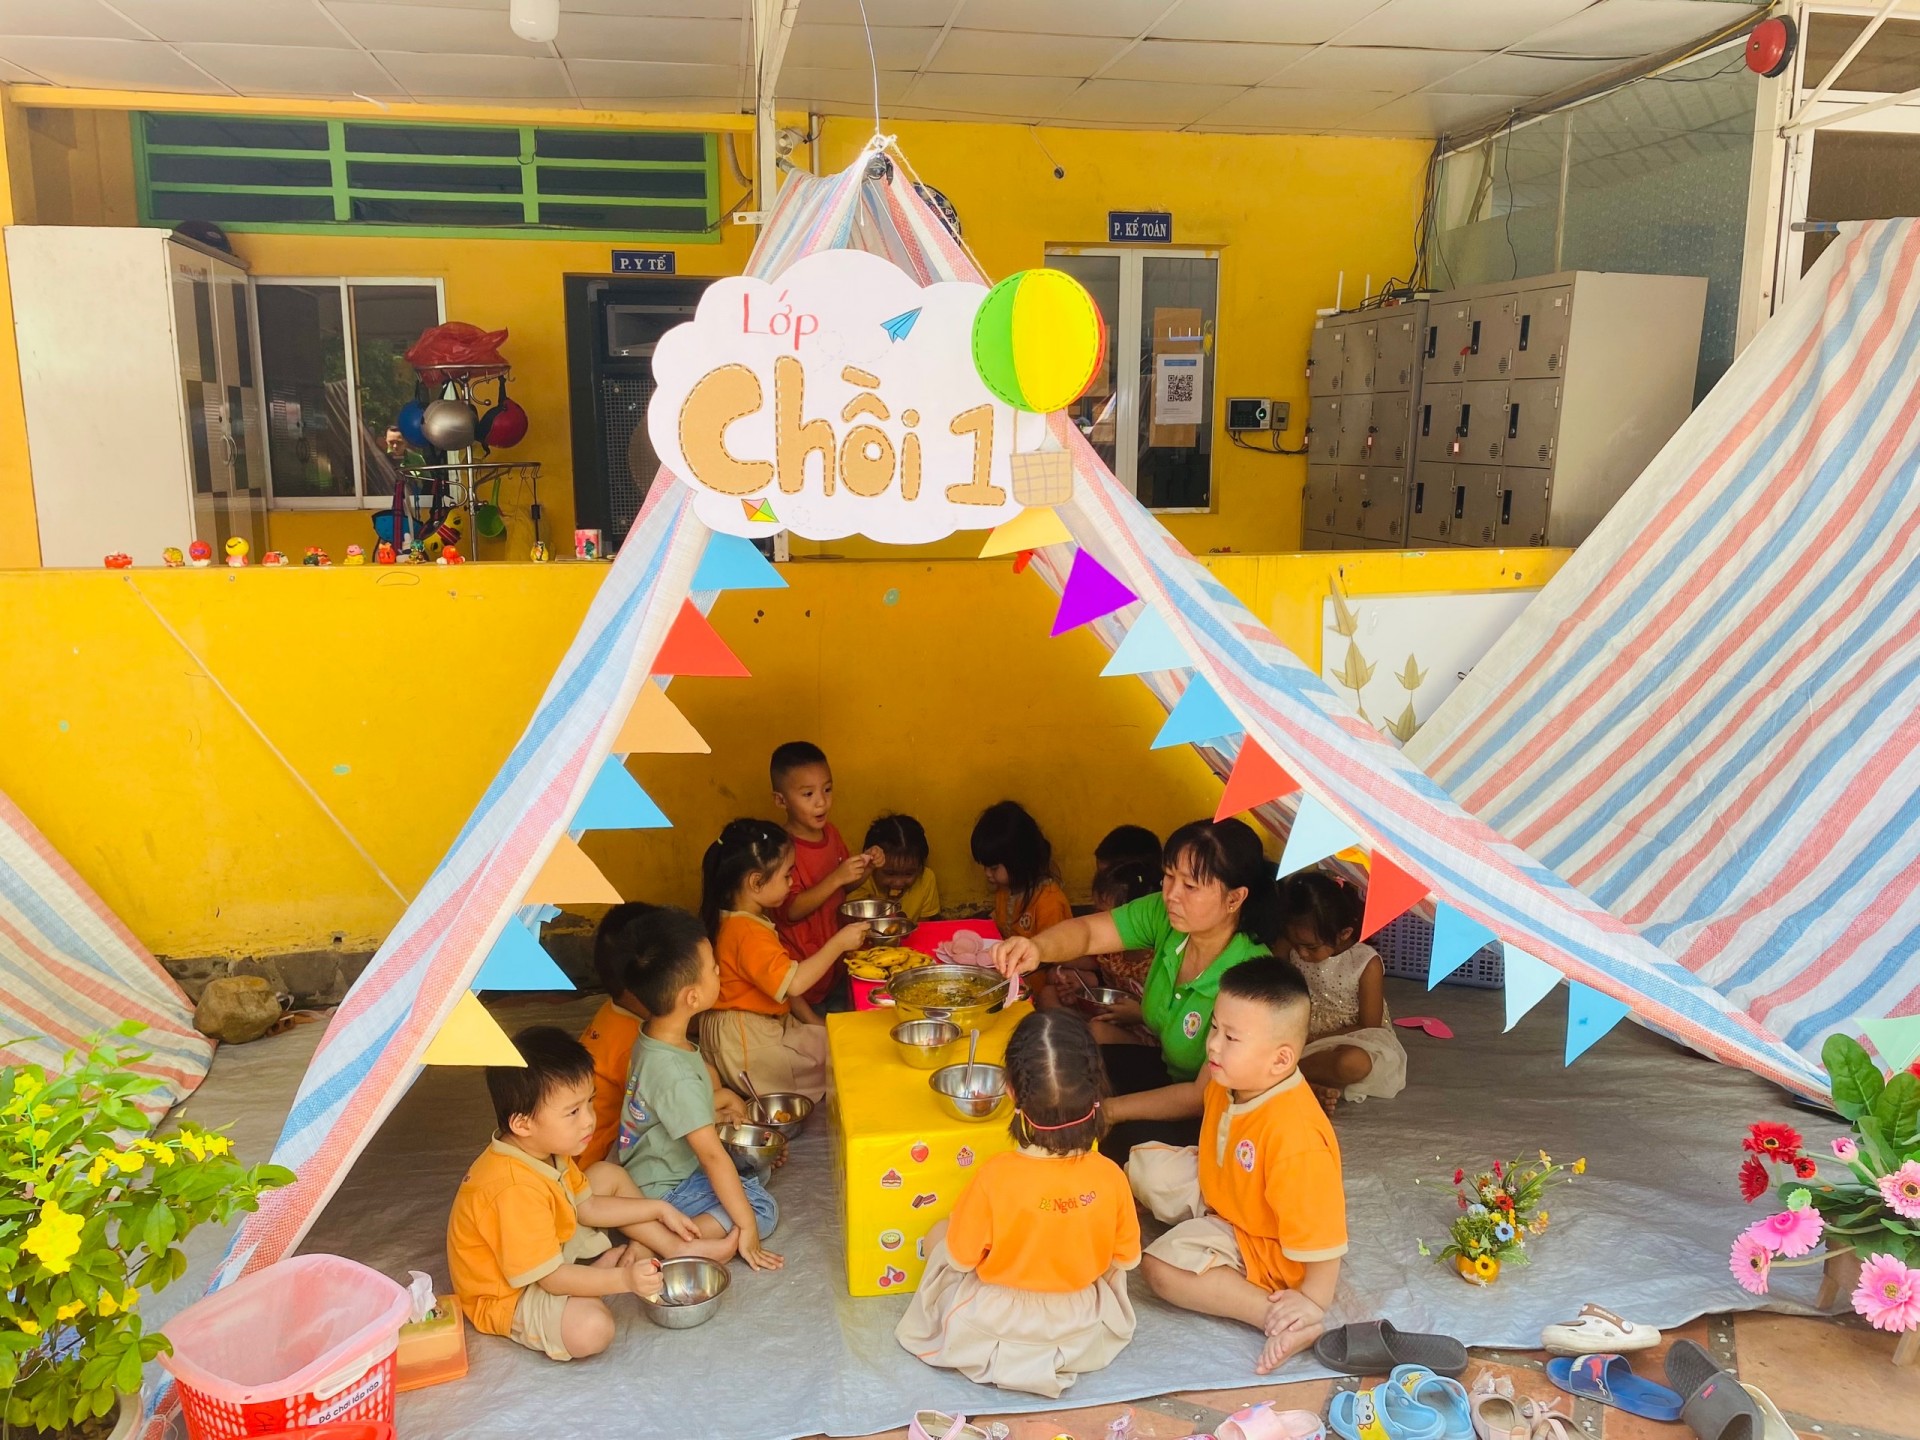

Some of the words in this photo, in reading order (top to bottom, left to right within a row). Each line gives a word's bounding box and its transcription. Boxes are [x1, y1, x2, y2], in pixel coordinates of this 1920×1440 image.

[1113, 222, 1123, 236] P.
[1125, 216, 1140, 236] KẾ
[1141, 219, 1167, 237] TOÁN
[620, 257, 632, 270] P.
[634, 258, 644, 270] Y
[647, 253, 667, 271] TẾ
[743, 289, 819, 351] Lớp
[678, 354, 922, 502] Chồi
[944, 403, 1007, 507] 1
[1053, 1197, 1079, 1214] Ngôi
[1079, 1190, 1097, 1207] Sao
